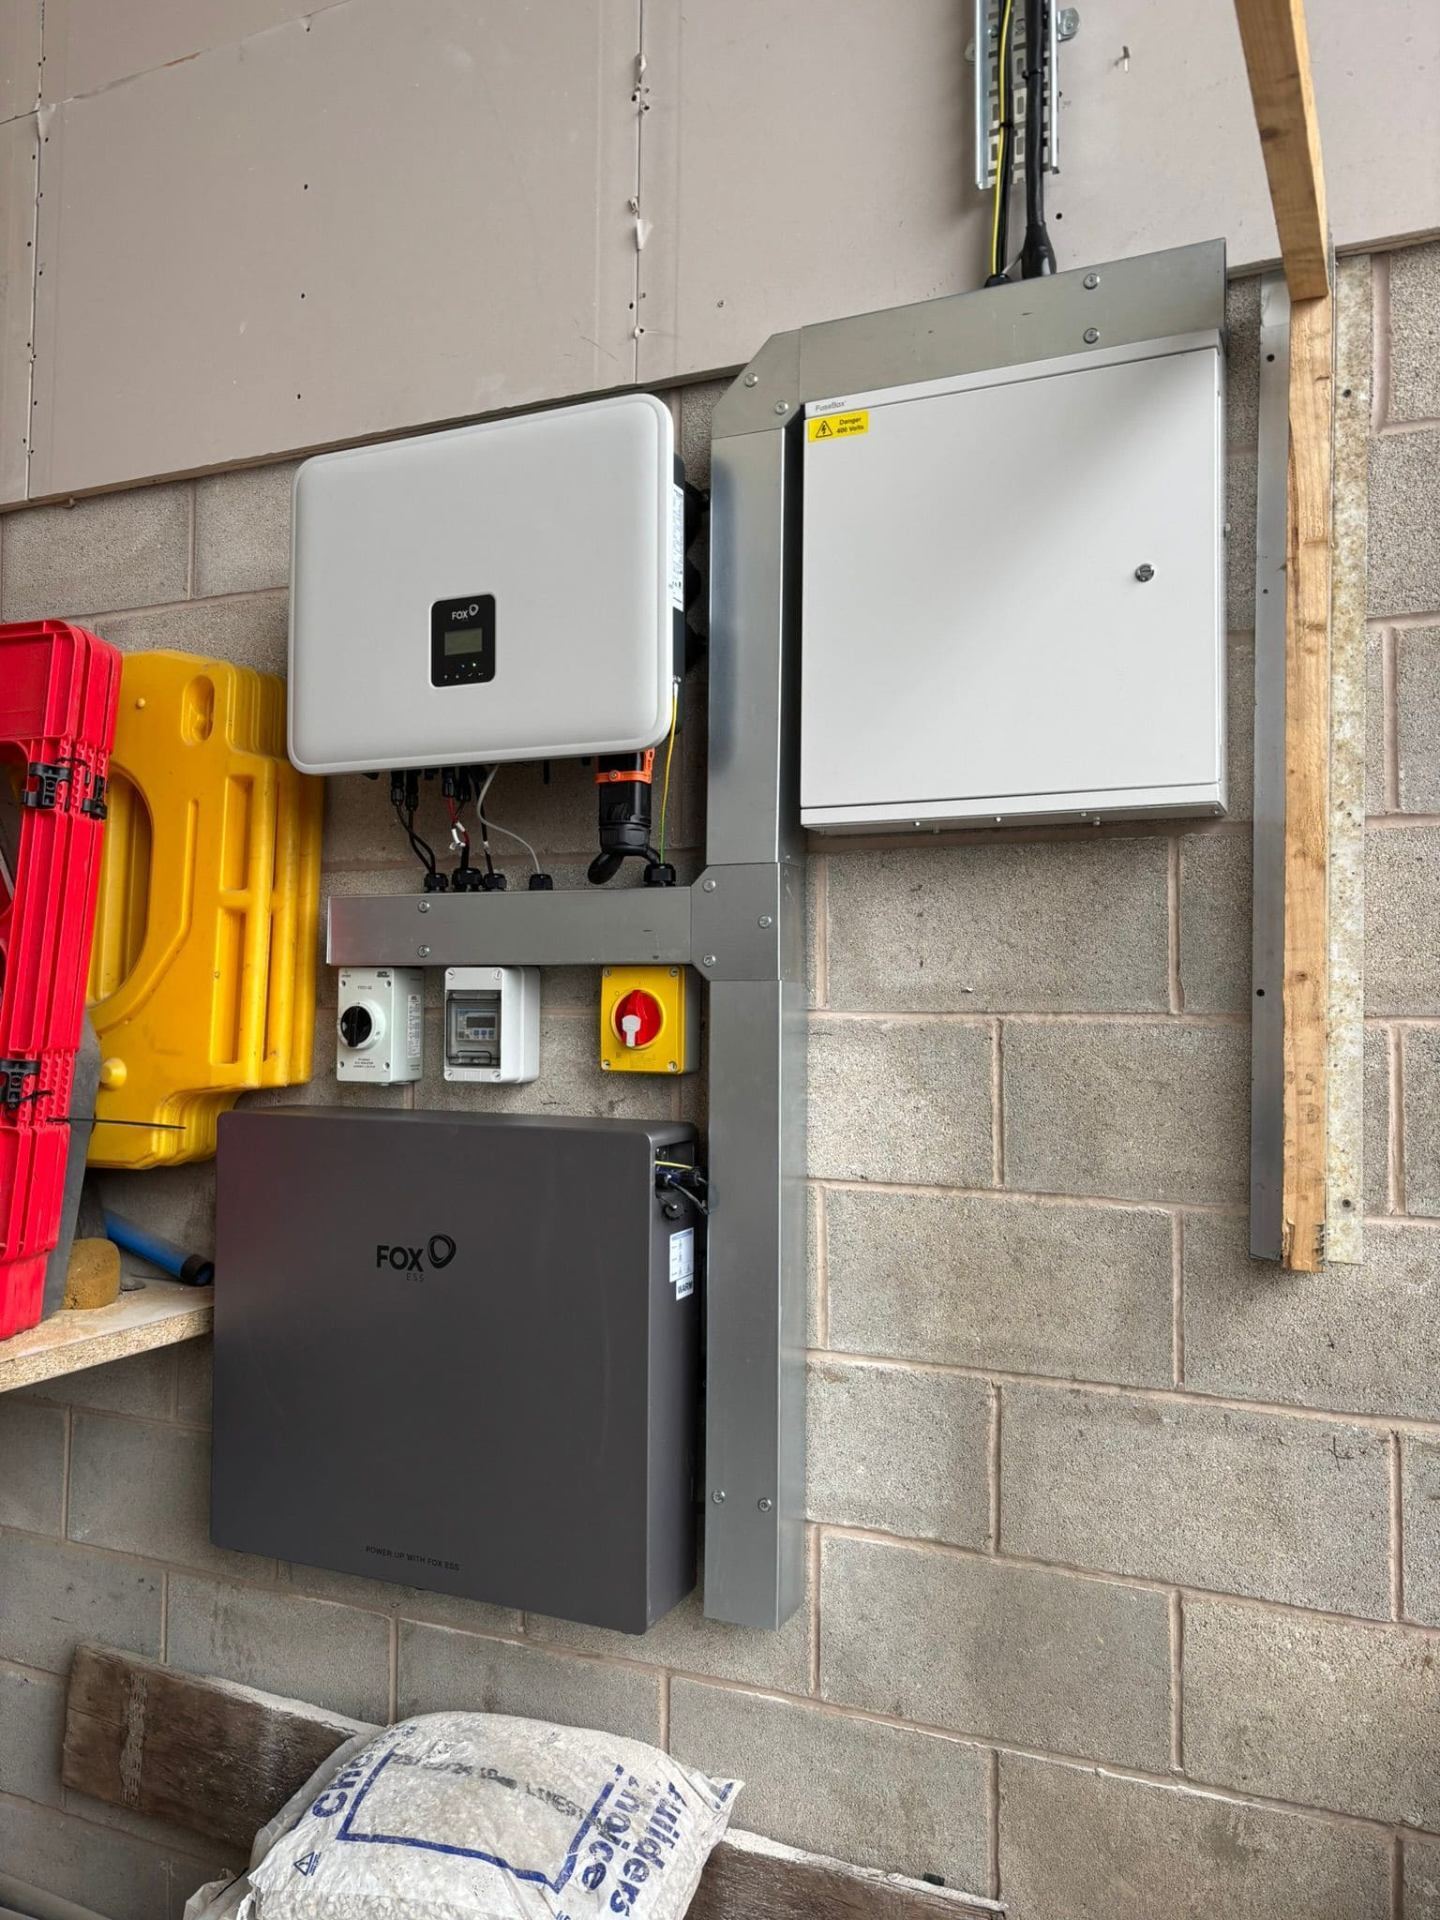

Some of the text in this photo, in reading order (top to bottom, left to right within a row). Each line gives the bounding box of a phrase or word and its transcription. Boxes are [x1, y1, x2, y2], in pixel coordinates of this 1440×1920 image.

[451, 610, 468, 620] FOX
[376, 1244, 424, 1272] FOX
[406, 1272, 425, 1282] ESS
[365, 1545, 460, 1571] POWER UP WITH FOX ESS
